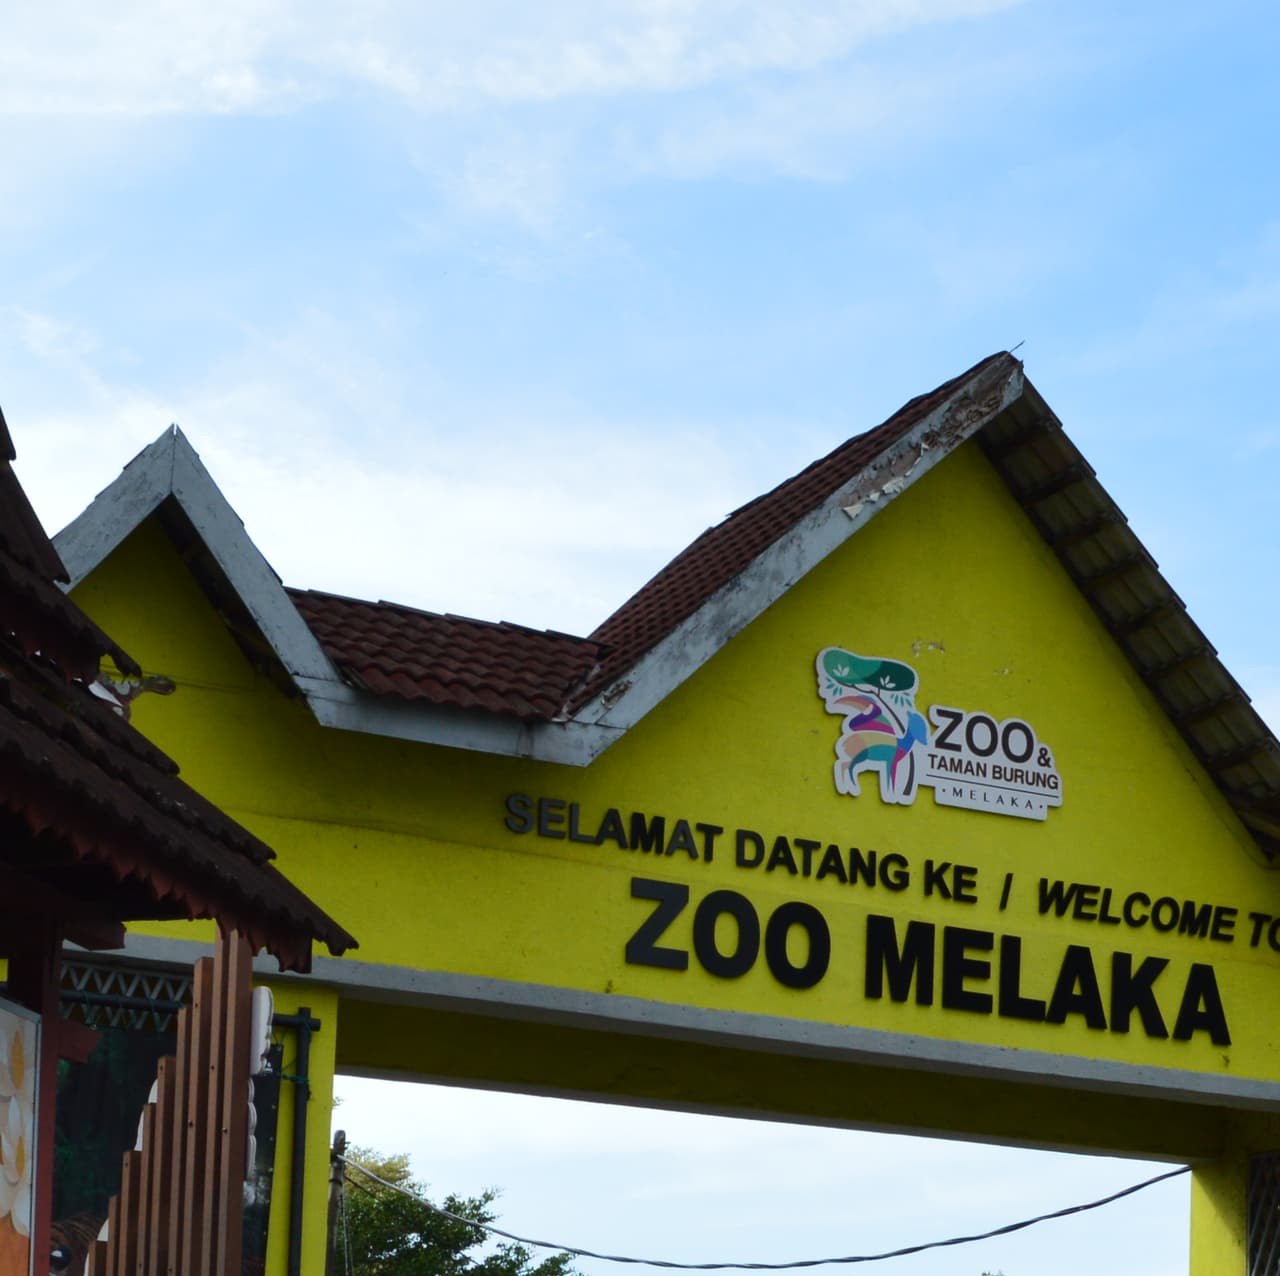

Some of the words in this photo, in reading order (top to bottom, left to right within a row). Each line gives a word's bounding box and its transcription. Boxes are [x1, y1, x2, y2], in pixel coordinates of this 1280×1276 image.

[934, 708, 1035, 764] ZOO
[1037, 747, 1052, 768] &
[927, 753, 988, 778] TAMAN
[992, 764, 1059, 791] BURUNG
[952, 786, 1033, 810] MELAKA
[503, 793, 724, 864] SELAMAT
[735, 828, 911, 892] DATANG
[924, 858, 979, 904] KE
[1038, 877, 1239, 943] WELCOME
[624, 876, 832, 990] ZOO
[864, 914, 1232, 1047] MELAKA
